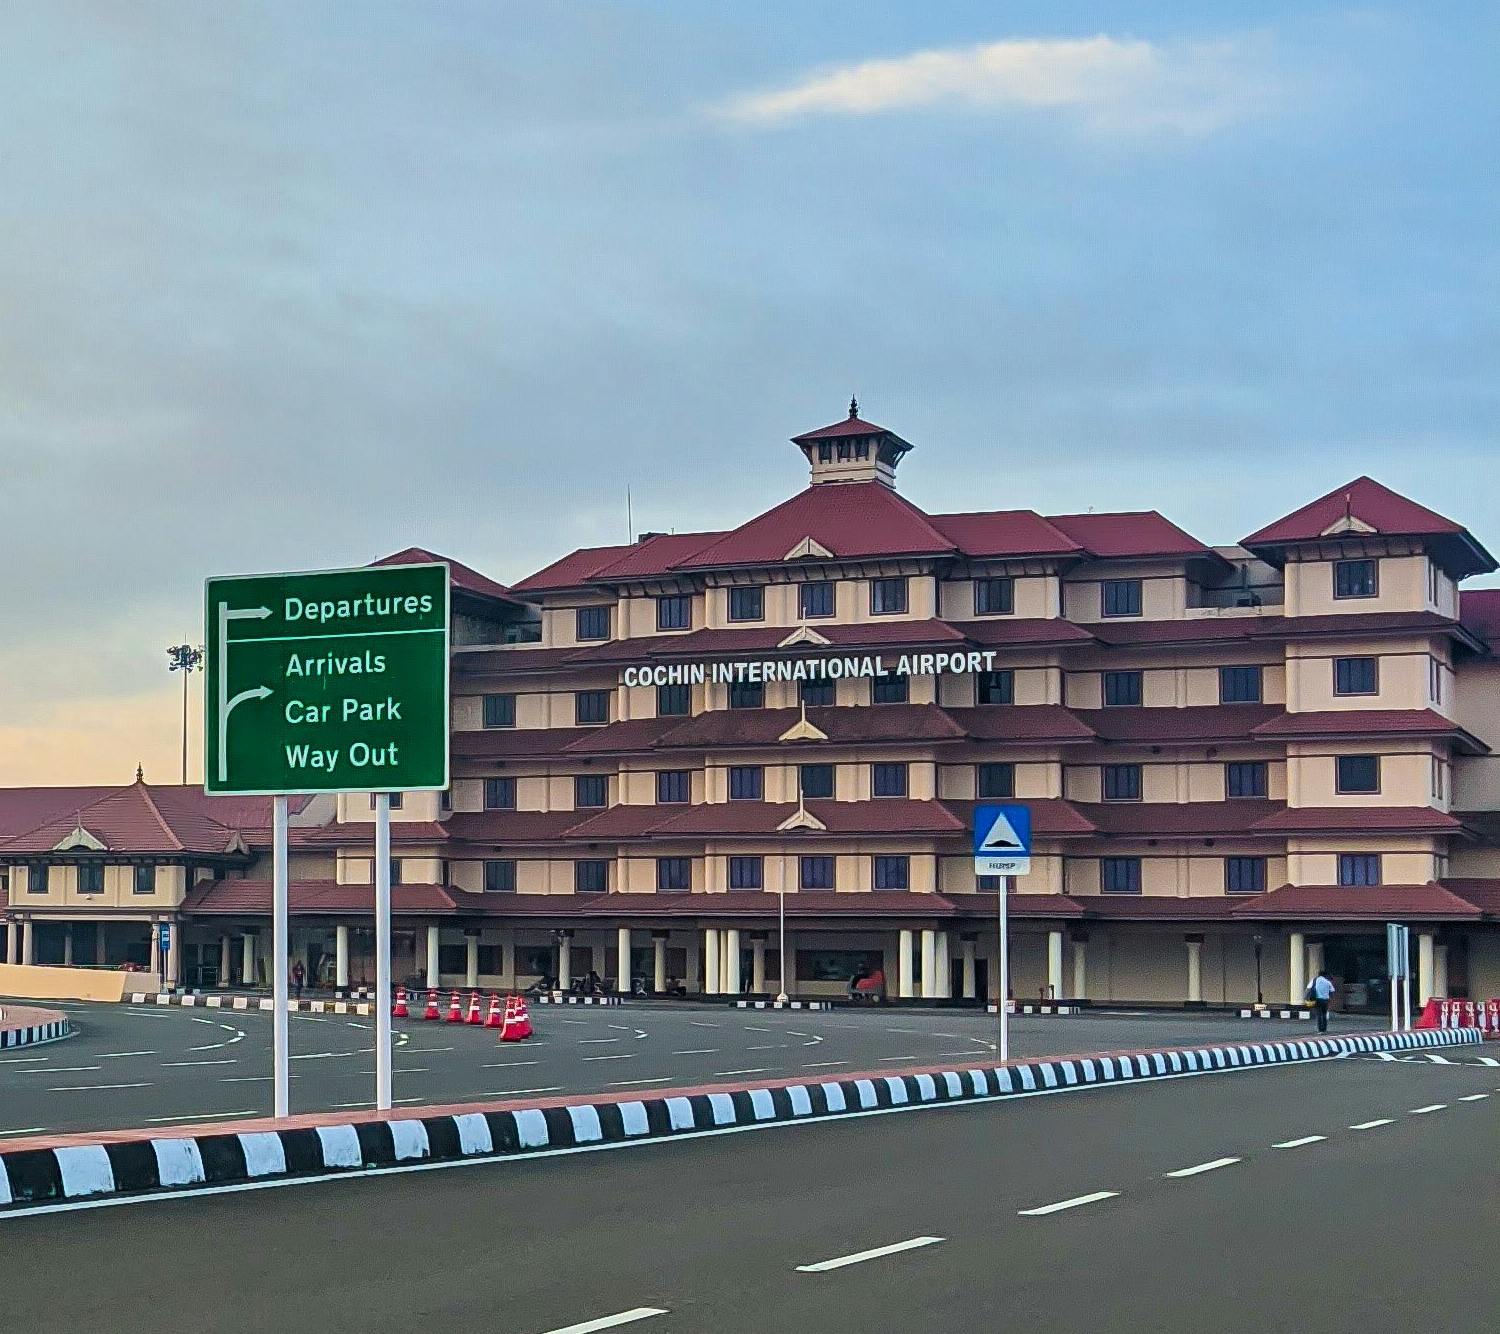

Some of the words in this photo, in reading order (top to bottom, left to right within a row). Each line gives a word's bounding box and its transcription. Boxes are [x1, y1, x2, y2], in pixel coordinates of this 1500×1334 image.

[285, 593, 433, 623] Departures
[286, 650, 386, 677] Arrivals
[624, 663, 705, 687] COCHIN
[712, 656, 888, 684] INTERNATIONAL
[896, 651, 997, 676] AIRPORT
[285, 700, 331, 723] Car
[343, 697, 401, 722] Park
[285, 744, 339, 772] Way
[350, 742, 398, 767] Out
